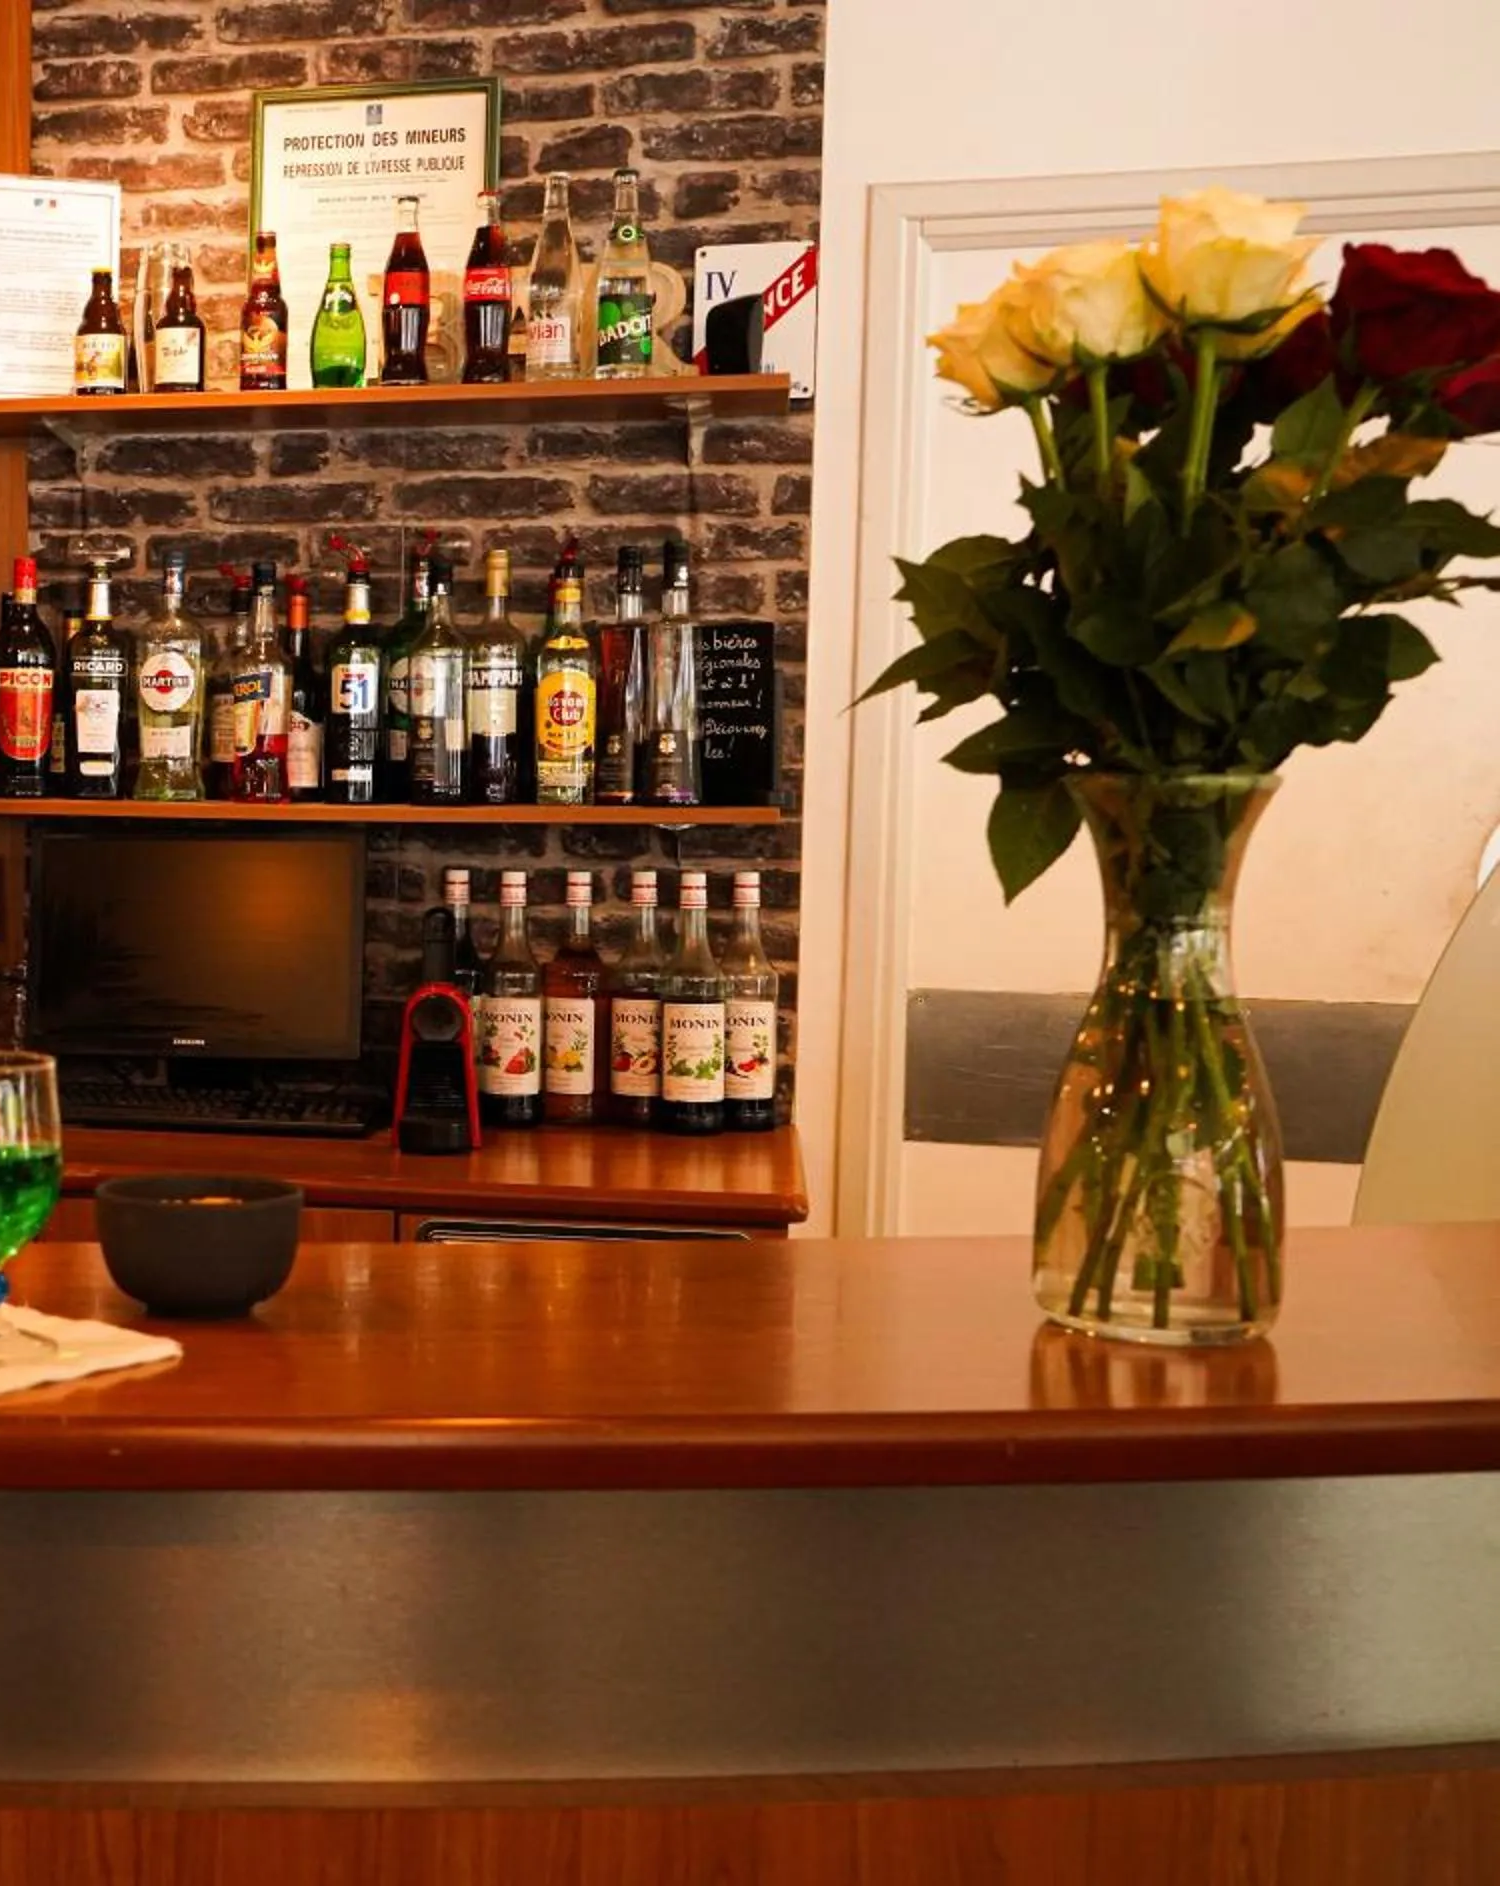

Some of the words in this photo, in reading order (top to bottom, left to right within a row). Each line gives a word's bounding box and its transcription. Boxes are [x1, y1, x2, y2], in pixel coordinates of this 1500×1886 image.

[283, 132, 365, 152] PROTECTION
[372, 130, 398, 147] DES
[405, 127, 466, 145] MINEURS
[347, 160, 360, 175] DE
[417, 154, 465, 172] PUBLIQUE
[706, 270, 737, 300] IV
[73, 661, 123, 673] RICARD
[0, 671, 53, 687] PICON
[142, 675, 189, 689] MARTINI
[339, 680, 369, 710] 51
[483, 1012, 533, 1023] MONIN
[547, 1012, 583, 1023] ONIN
[672, 1018, 720, 1029] MONIN
[727, 1015, 768, 1027] ONIN
